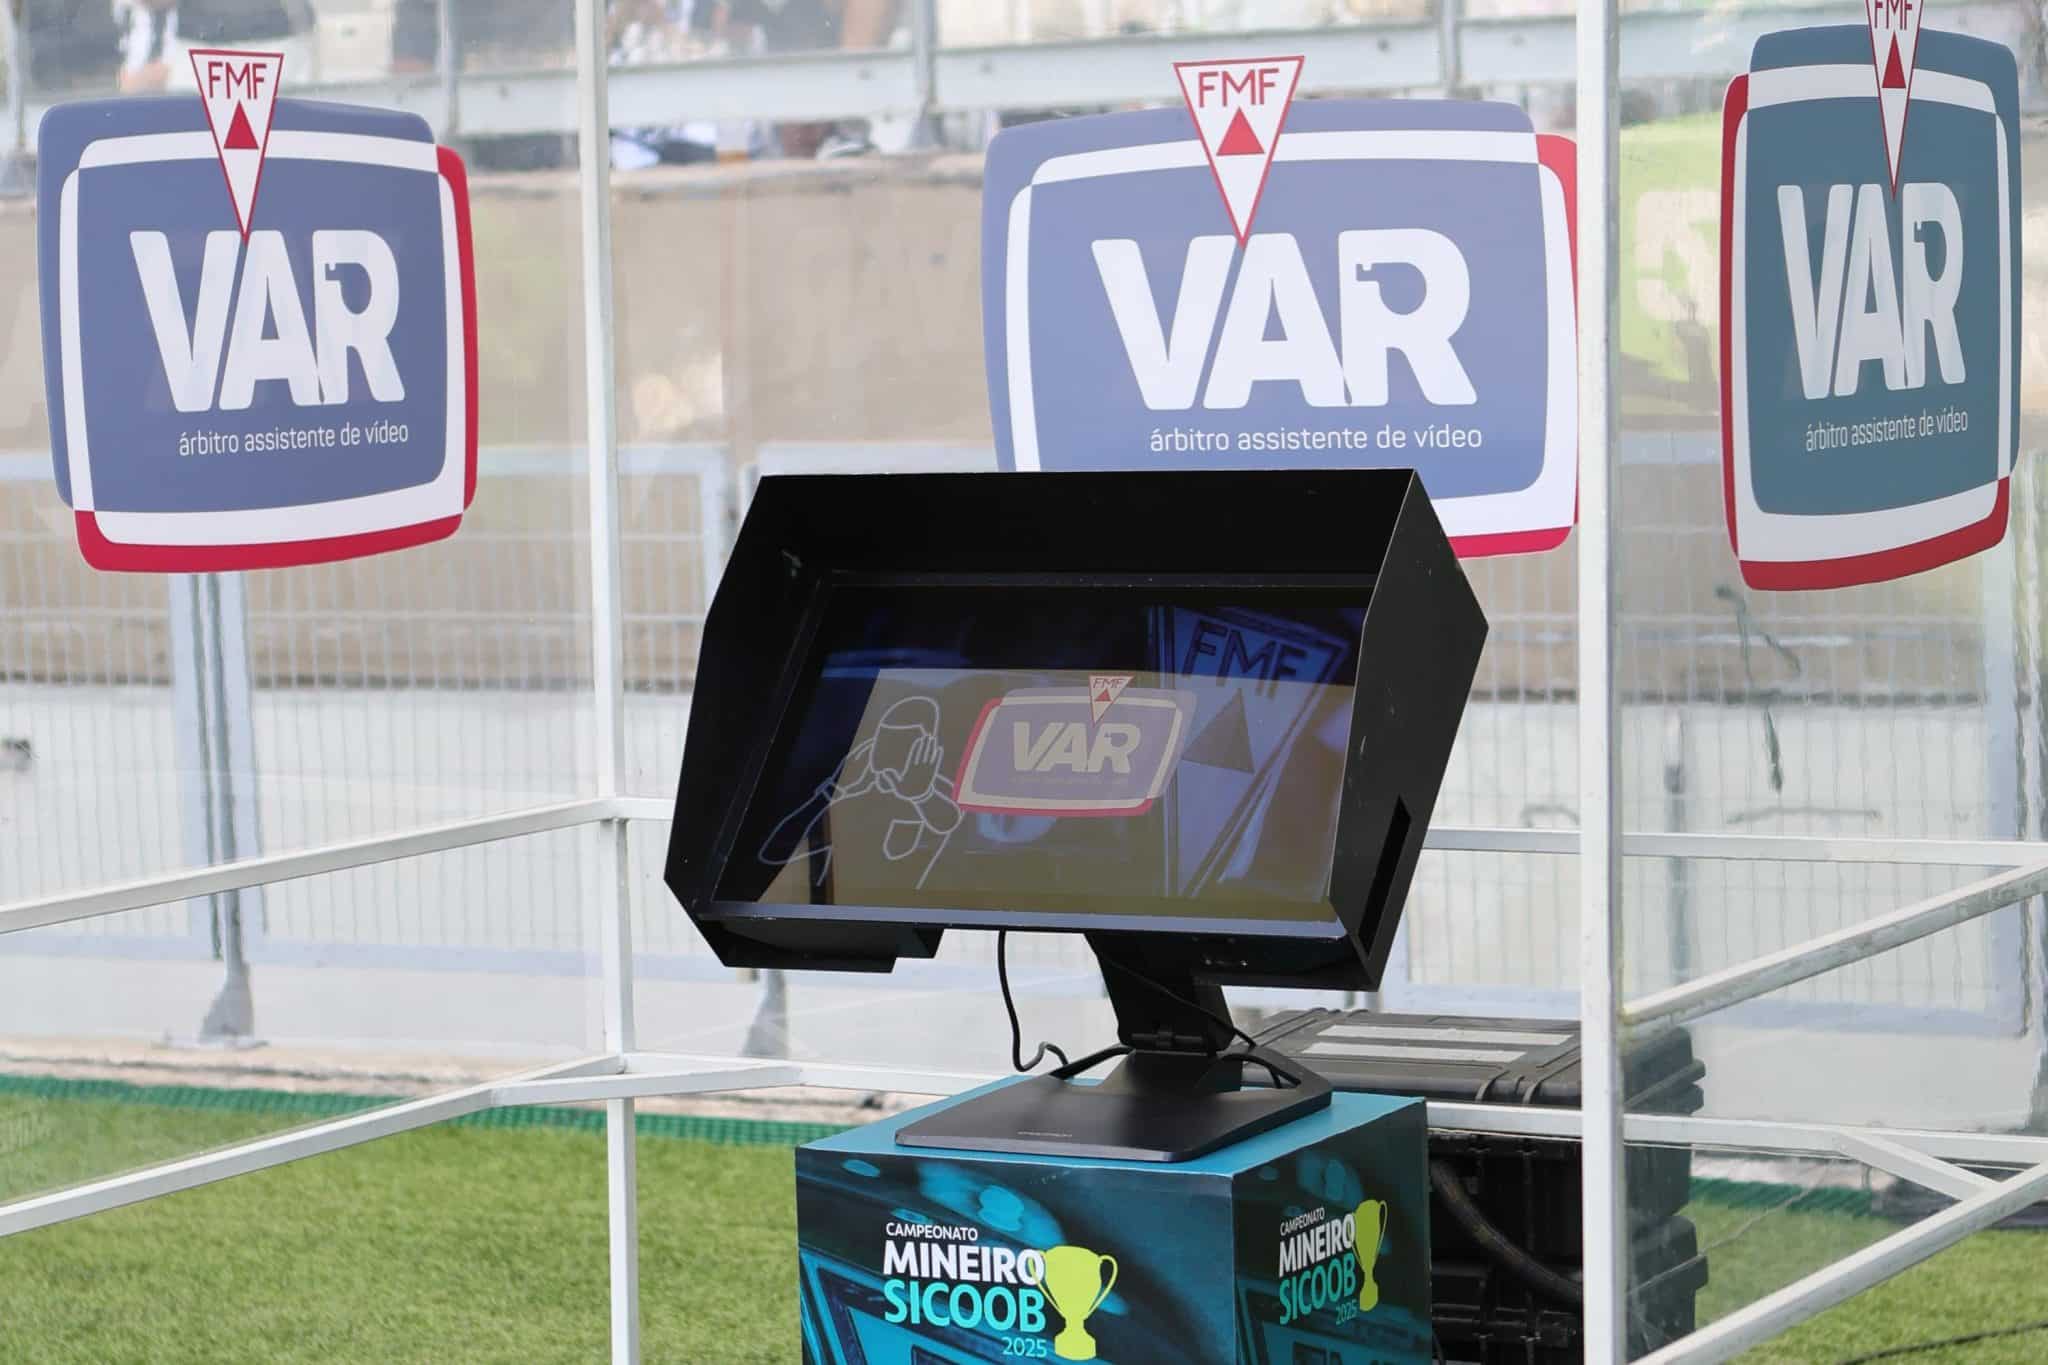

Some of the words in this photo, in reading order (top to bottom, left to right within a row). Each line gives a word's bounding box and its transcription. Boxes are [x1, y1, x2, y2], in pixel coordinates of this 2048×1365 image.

[209, 62, 267, 100] FMF
[1198, 67, 1280, 108] FMF
[1777, 182, 1966, 400] VAR
[129, 230, 405, 412] VAR
[1091, 228, 1478, 410] VAR
[179, 430, 239, 456] árbitro
[244, 427, 335, 452] assistente
[340, 421, 361, 446] de
[365, 420, 409, 444] vídeo
[1150, 428, 1229, 451] árbitro
[1237, 427, 1368, 450] assistente
[1376, 424, 1406, 449] de
[1414, 424, 1482, 449] vídeo
[1806, 419, 1848, 452] árbitro
[1851, 416, 1916, 446] assistente
[1918, 408, 1934, 437] de
[1181, 619, 1307, 699] FMF
[1092, 677, 1124, 689] FMF
[1013, 721, 1141, 774] VAR
[885, 1222, 978, 1241] CAMPEONATO
[1280, 1207, 1325, 1236] CAMPEONATO
[883, 1239, 1045, 1286] MINEIRO
[1279, 1213, 1355, 1278] MINEIRO
[883, 1278, 1046, 1333] SICOOB
[1279, 1252, 1356, 1325] SICOOB
[1335, 1299, 1358, 1325] 2025
[1001, 1336, 1047, 1358] 2025
